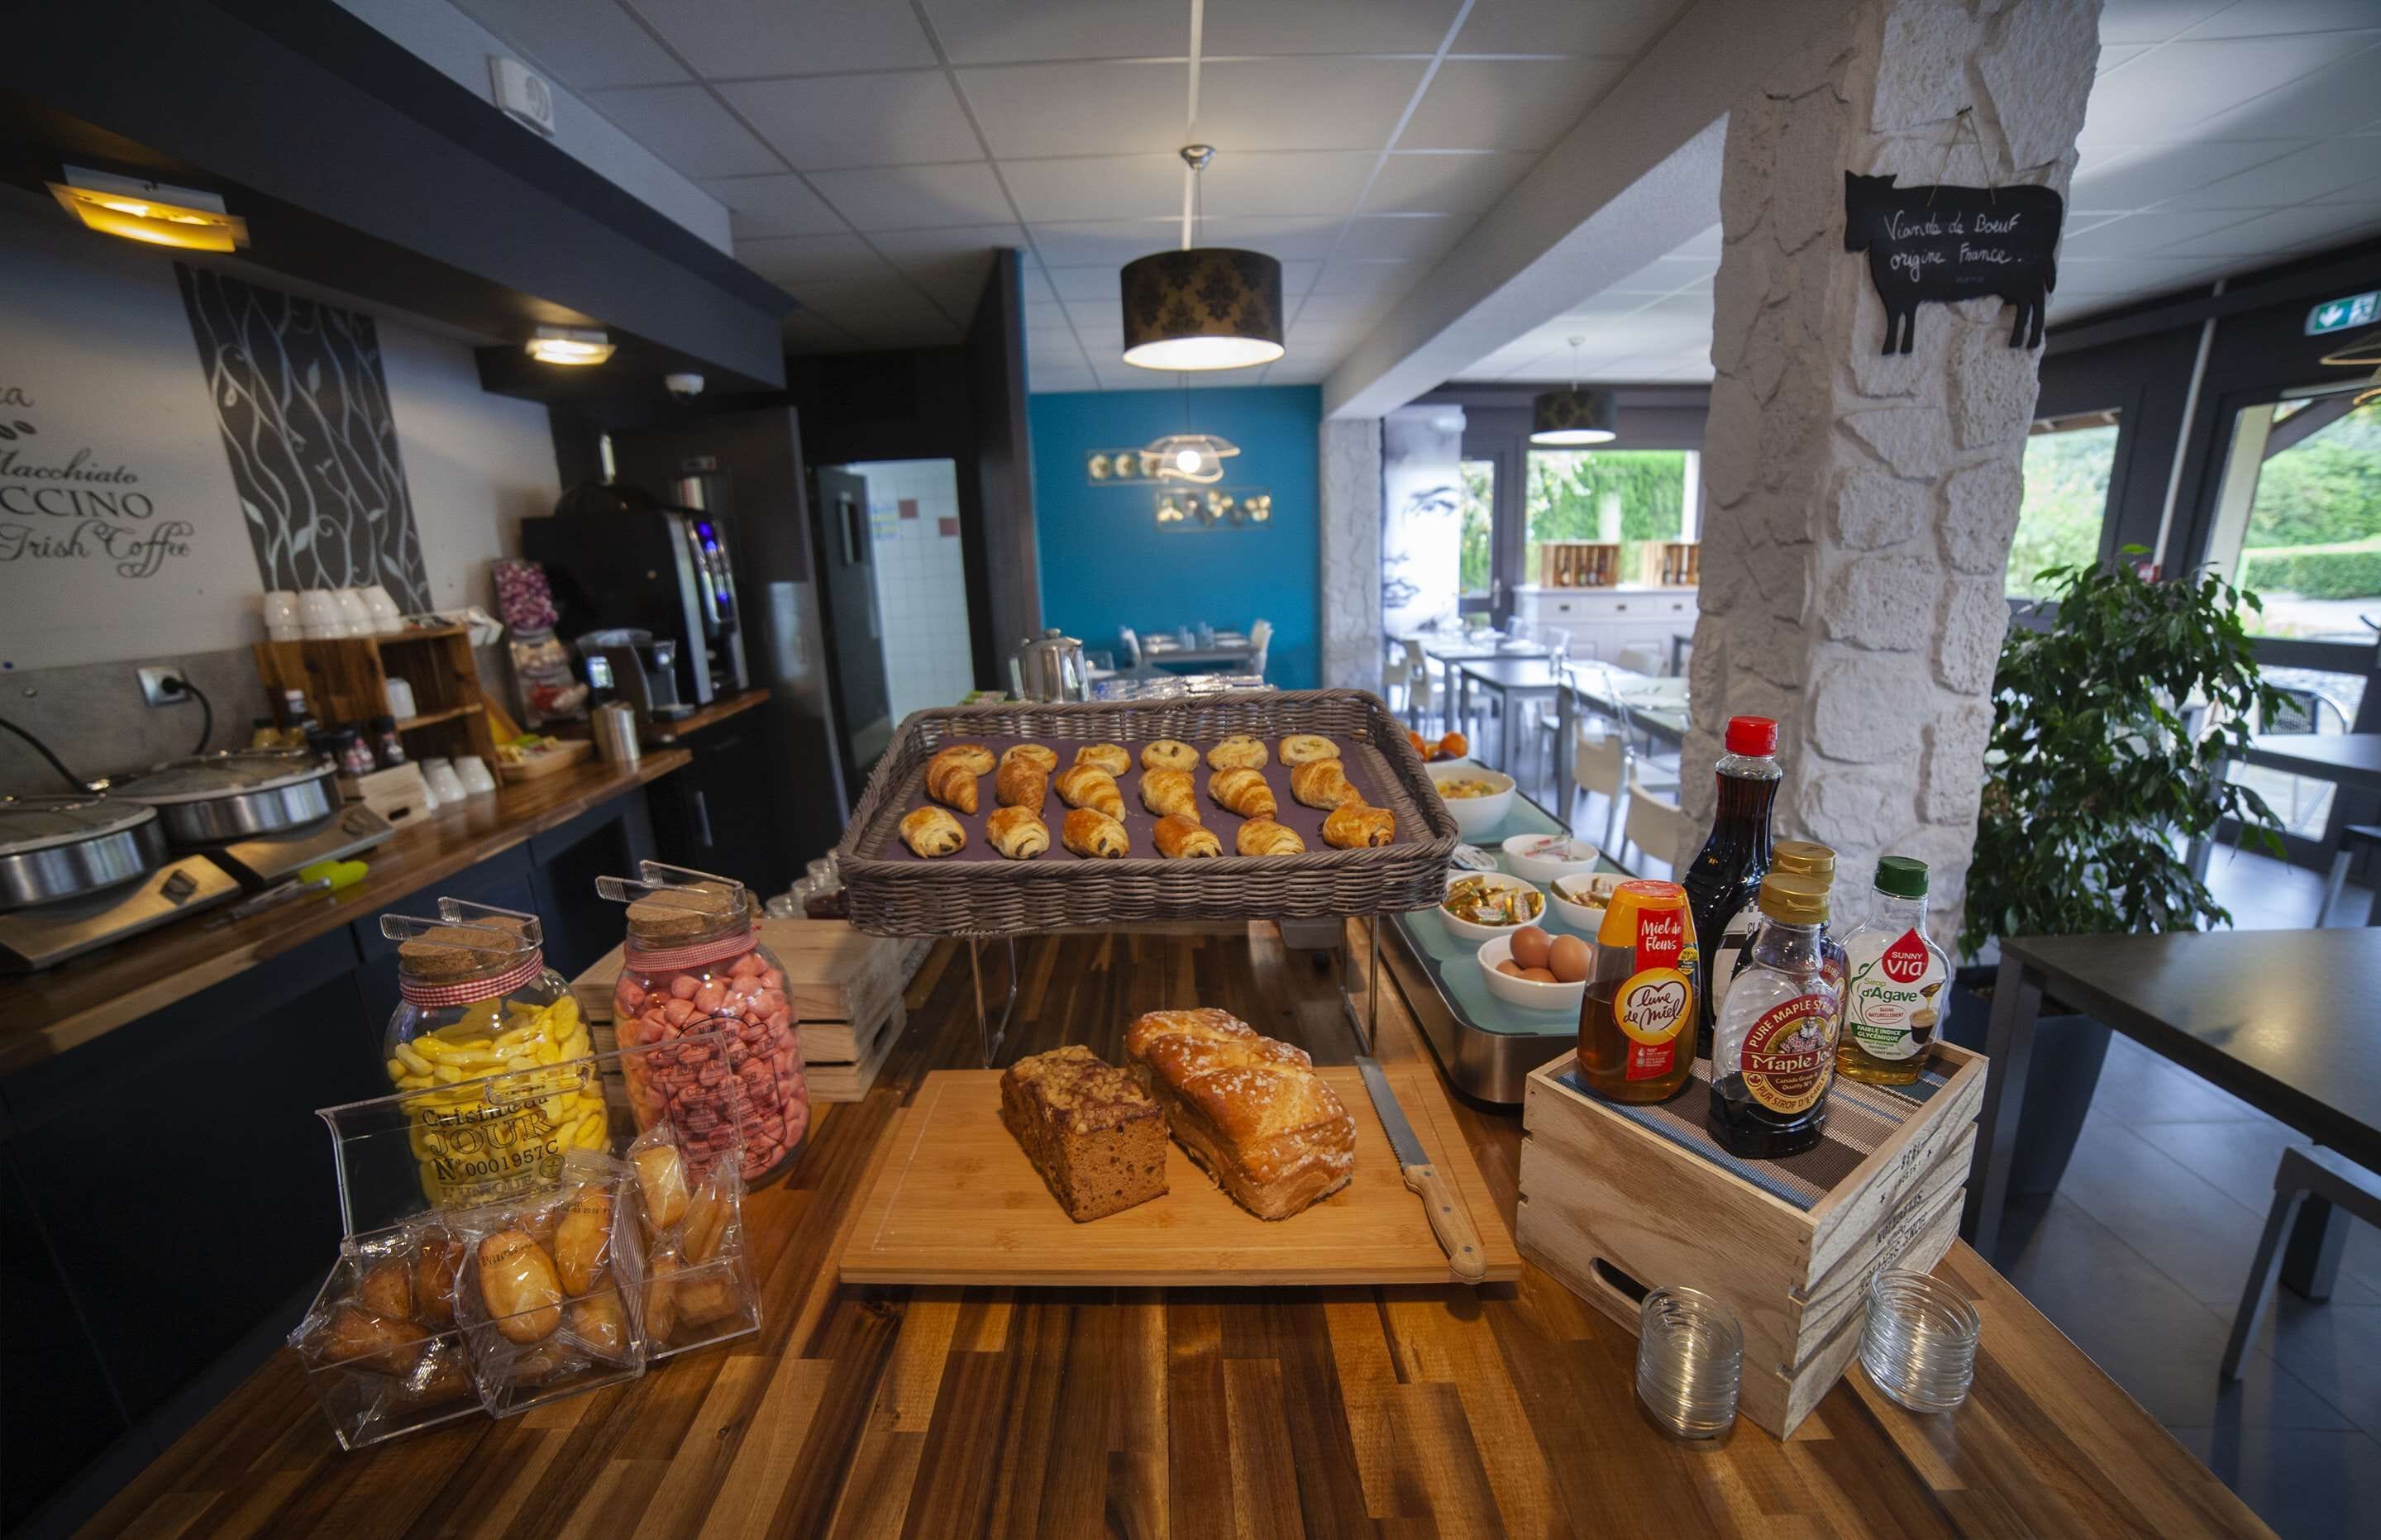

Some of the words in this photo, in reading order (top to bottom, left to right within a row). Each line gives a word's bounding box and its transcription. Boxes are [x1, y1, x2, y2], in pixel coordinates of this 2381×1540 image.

[1883, 210, 1942, 241] Viande
[1948, 211, 1964, 235] de
[1890, 248, 1945, 283] origine
[105, 521, 195, 578] Coffee
[1641, 917, 1671, 937] Miel
[1672, 922, 1682, 935] de
[1645, 936, 1677, 952] Fleurs
[1862, 986, 1918, 1003] d'Agave
[1864, 978, 1887, 988] Sirop
[1623, 1011, 1639, 1023] de
[1749, 1020, 1774, 1048] PURE
[1773, 999, 1811, 1023] MAPLE
[1813, 999, 1835, 1015] SYRUP
[1857, 1025, 1879, 1033] FAIBLE
[1879, 1028, 1901, 1037] INDICE
[1750, 1054, 1812, 1074] Maple
[1814, 1047, 1833, 1066] Joe
[1756, 1085, 1773, 1101] PUR
[1771, 1097, 1798, 1109] SIROP
[422, 1103, 522, 1127] Cuisine
[430, 1109, 554, 1156] JOUR
